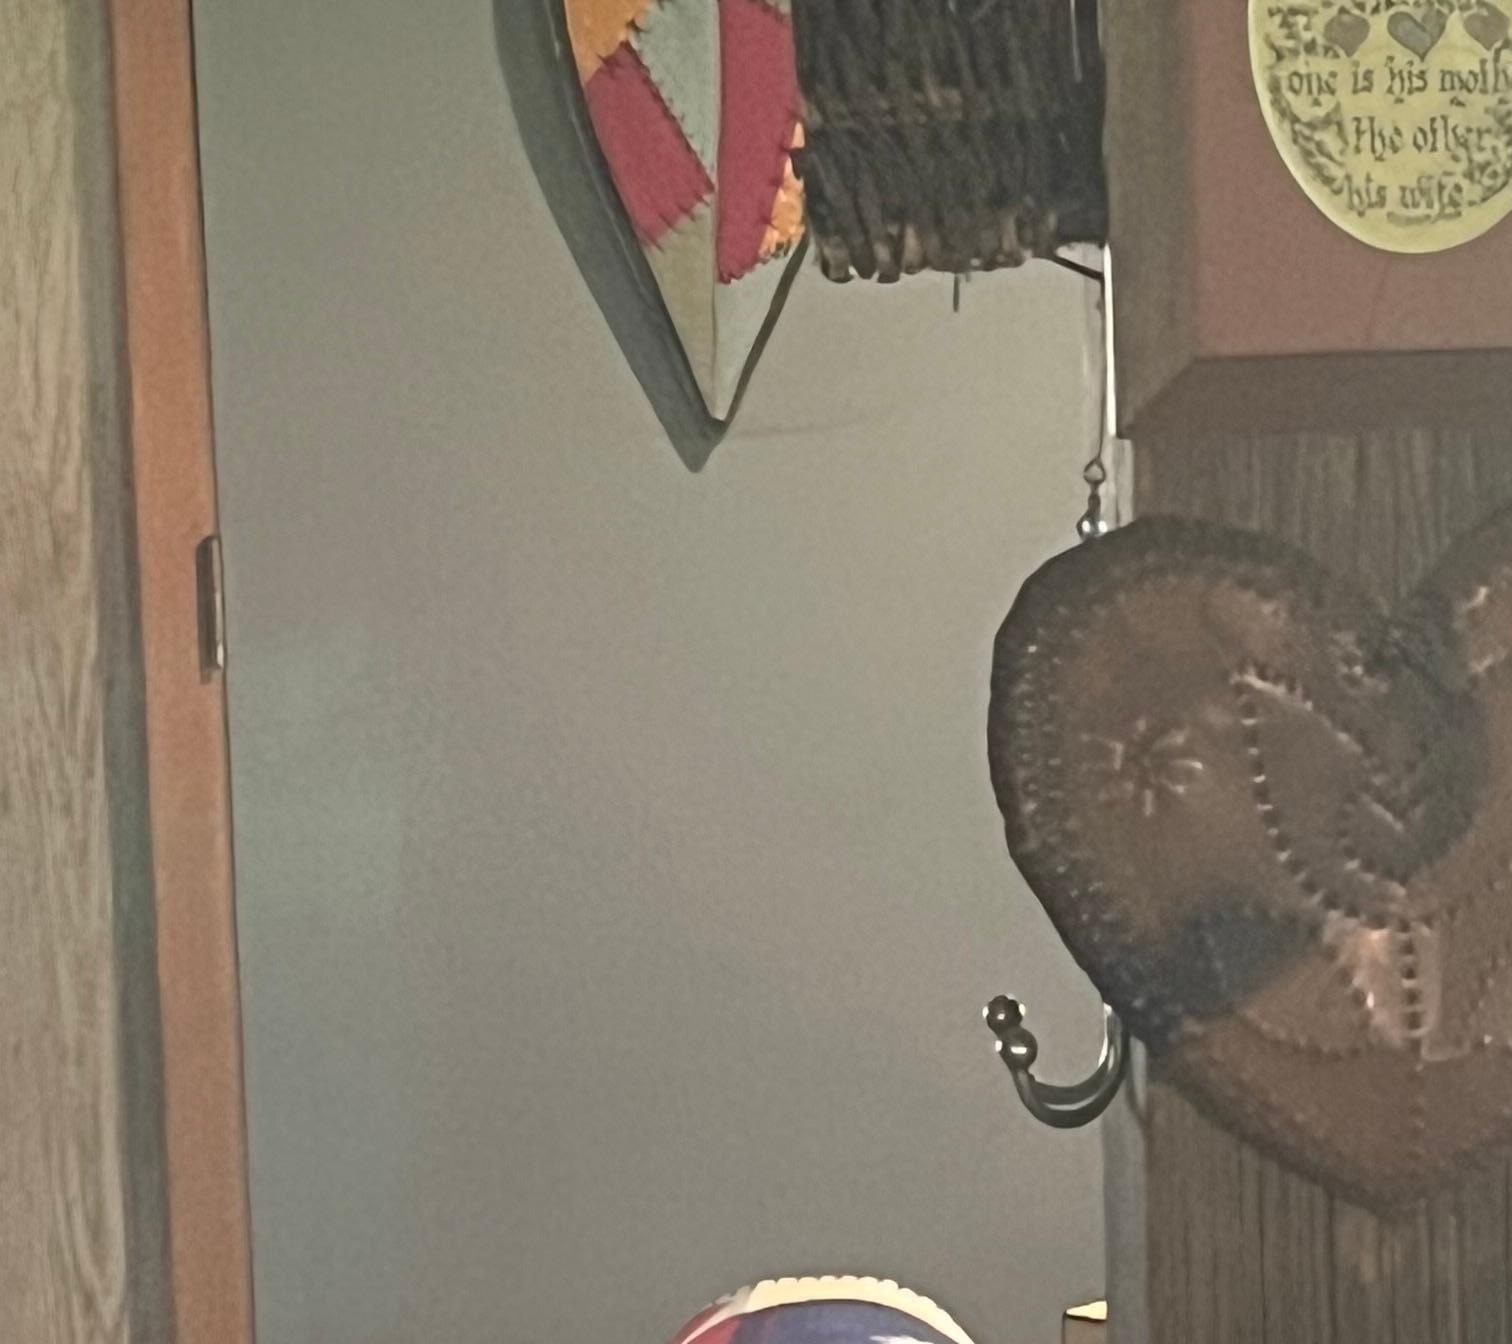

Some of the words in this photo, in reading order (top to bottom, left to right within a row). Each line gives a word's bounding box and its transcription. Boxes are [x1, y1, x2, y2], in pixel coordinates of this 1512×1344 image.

[1287, 69, 1338, 106] one
[1351, 60, 1374, 96] is
[1384, 55, 1428, 104] his
[1412, 113, 1492, 162] other
